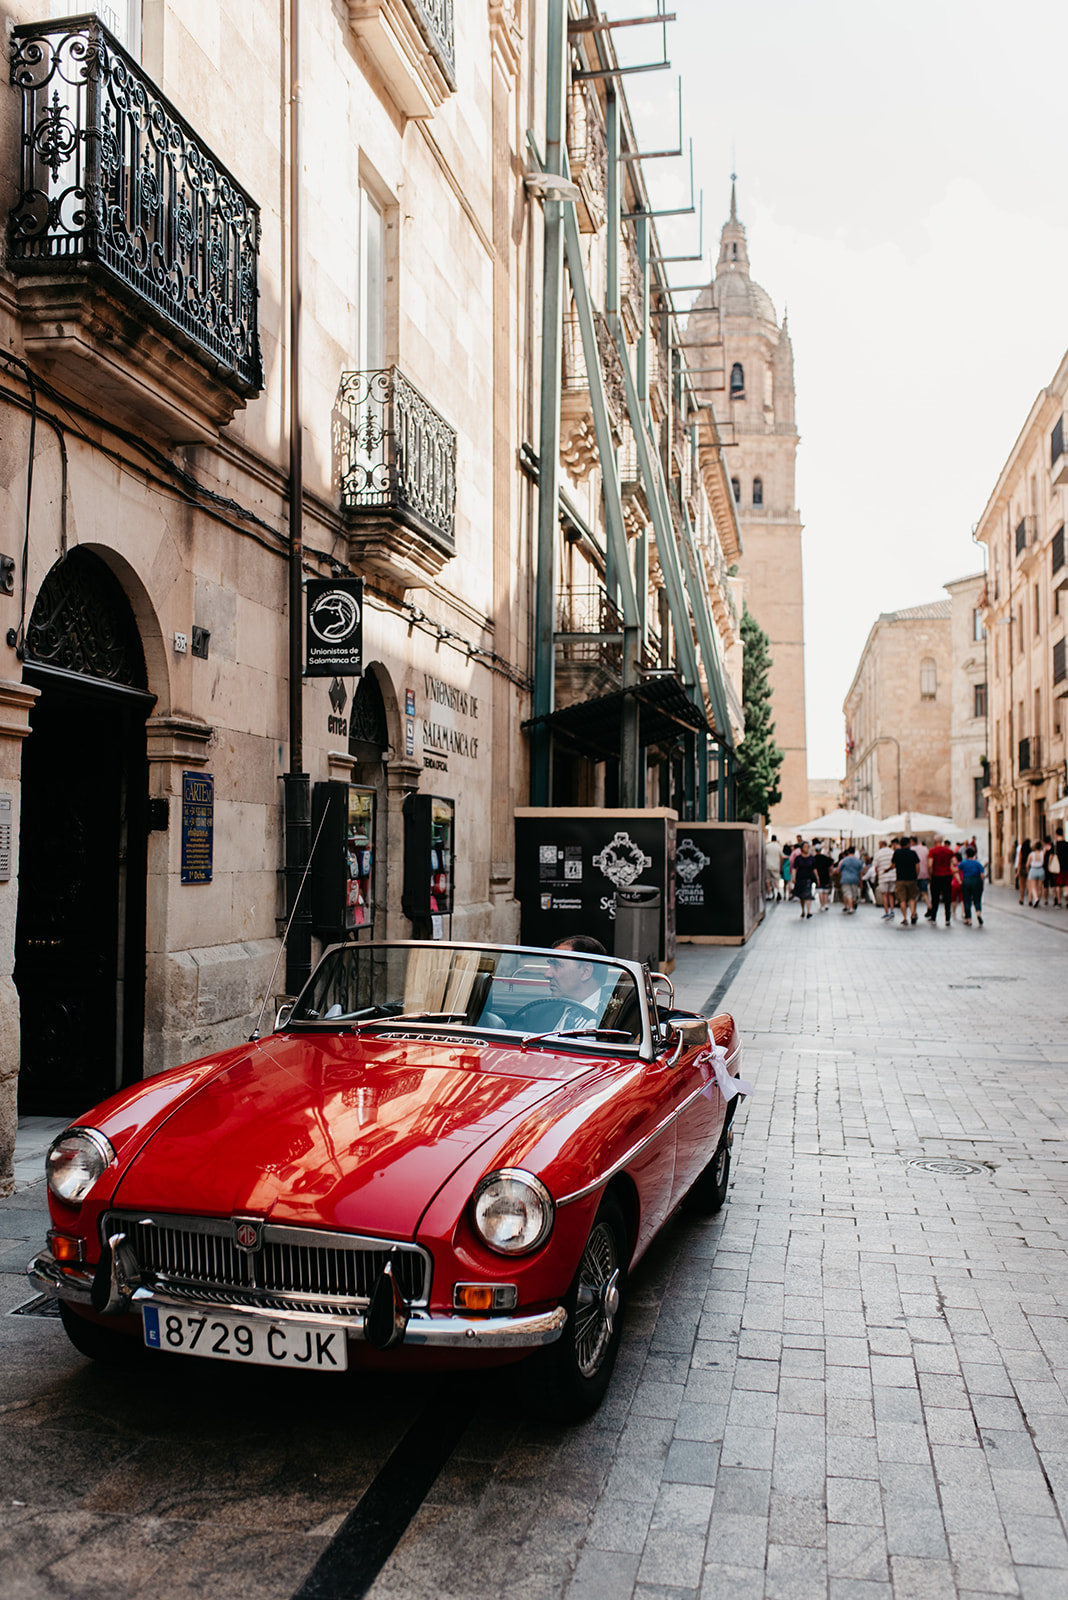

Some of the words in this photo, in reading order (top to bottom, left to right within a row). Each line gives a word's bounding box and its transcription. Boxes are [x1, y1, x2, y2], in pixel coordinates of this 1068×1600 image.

[308, 656, 349, 665] Salamanca
[350, 656, 360, 664] CF
[310, 647, 348, 655] Unionistas
[349, 647, 359, 655] de
[469, 695, 478, 719] DE
[328, 714, 347, 737] errea
[422, 719, 469, 757] SALAMANCA
[470, 737, 478, 759] CF
[678, 895, 704, 905] Santa
[239, 1226, 255, 1245] MG
[149, 1330, 156, 1340] E
[165, 1315, 254, 1356] 8729
